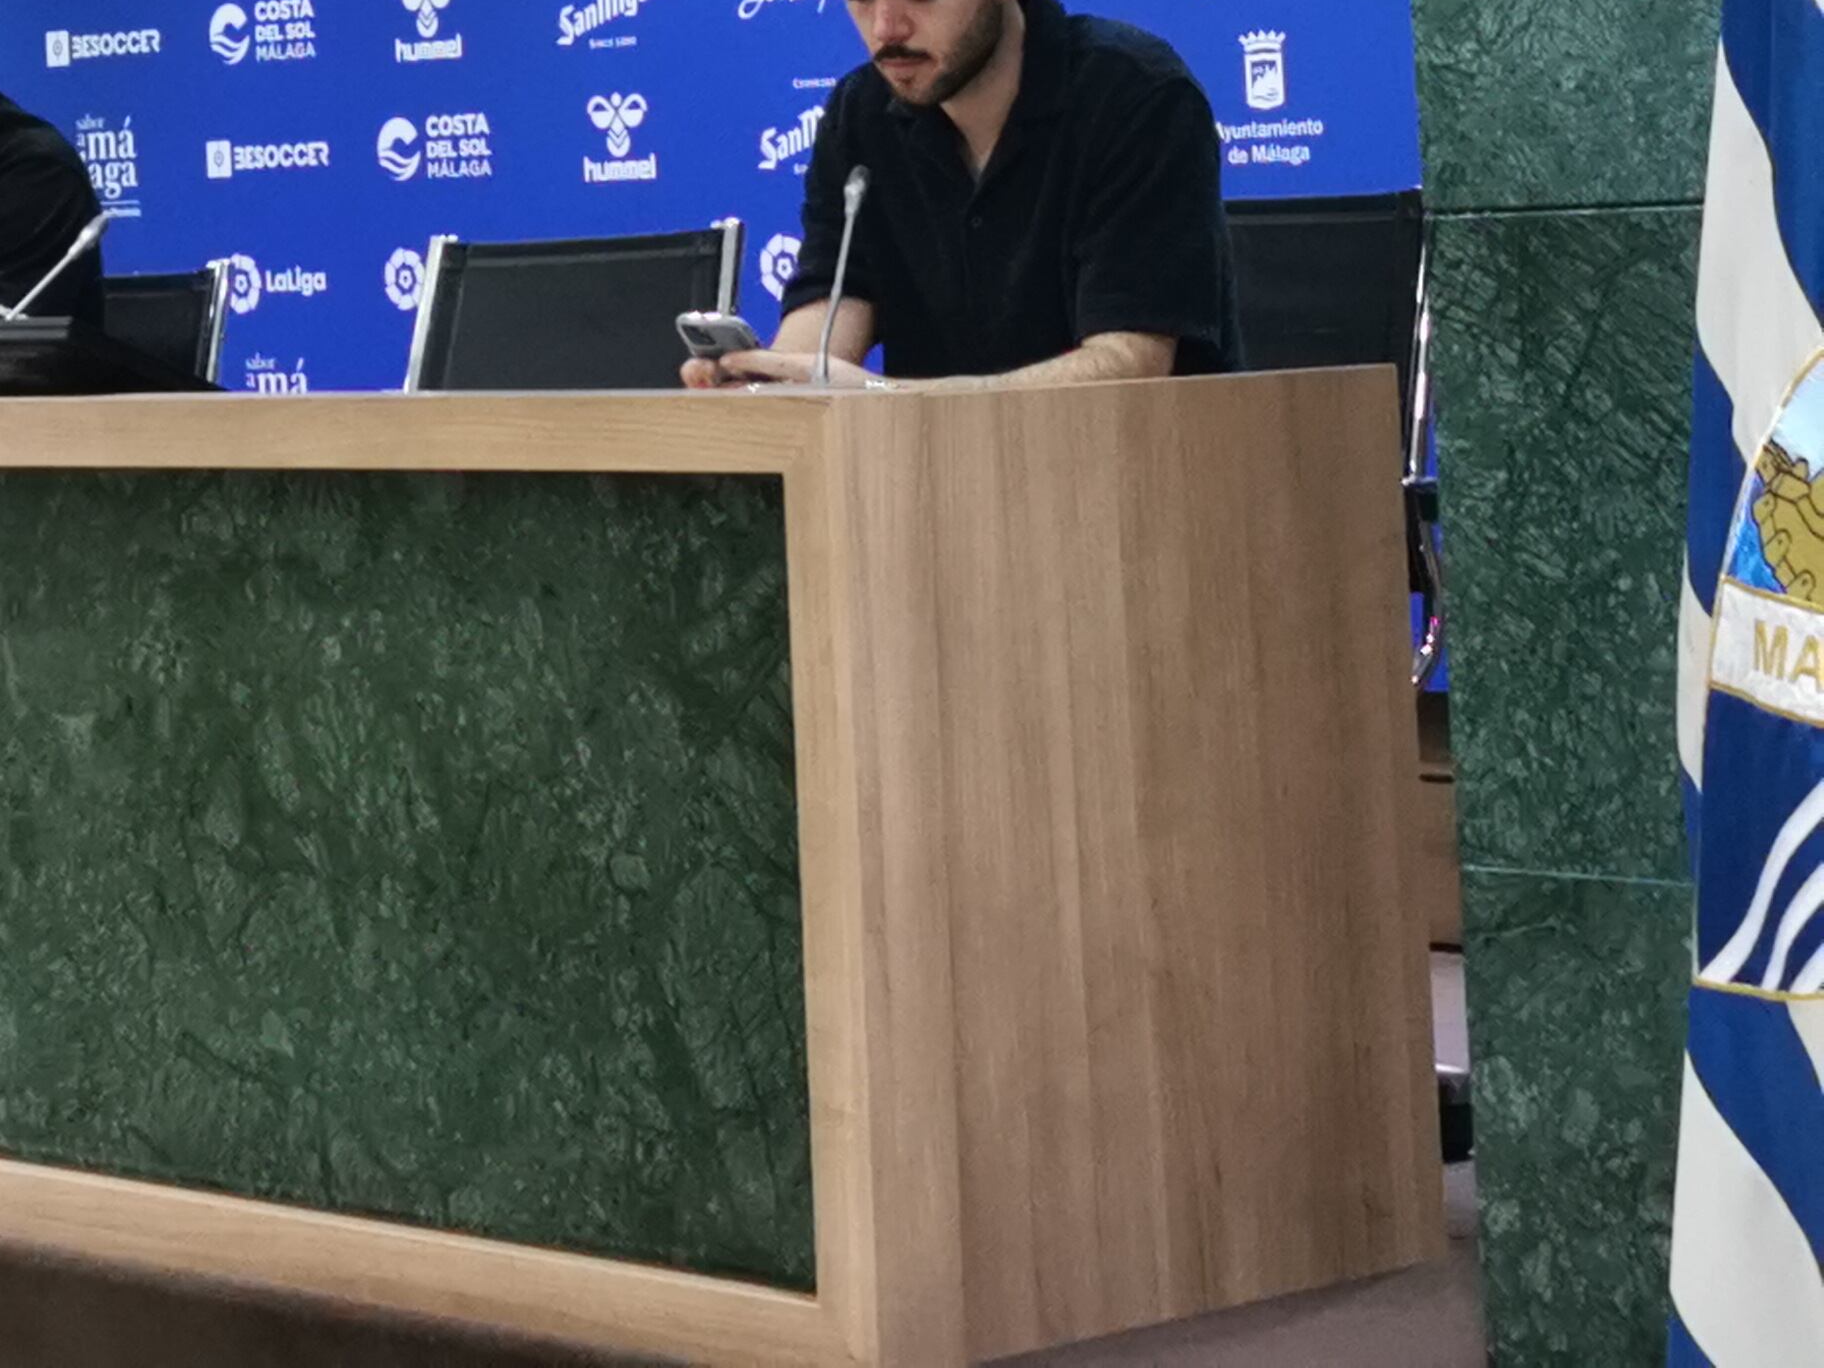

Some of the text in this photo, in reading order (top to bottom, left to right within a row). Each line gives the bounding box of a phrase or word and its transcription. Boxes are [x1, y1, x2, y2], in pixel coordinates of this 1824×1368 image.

[255, 21, 316, 43] DEL SOL
[395, 33, 463, 63] hummel
[425, 112, 490, 138] COSTA
[233, 141, 329, 170] BESOCCER
[426, 137, 492, 160] DEL SOL
[1227, 145, 1249, 165] de
[583, 153, 657, 183] hummel
[265, 265, 327, 297] LaLiga
